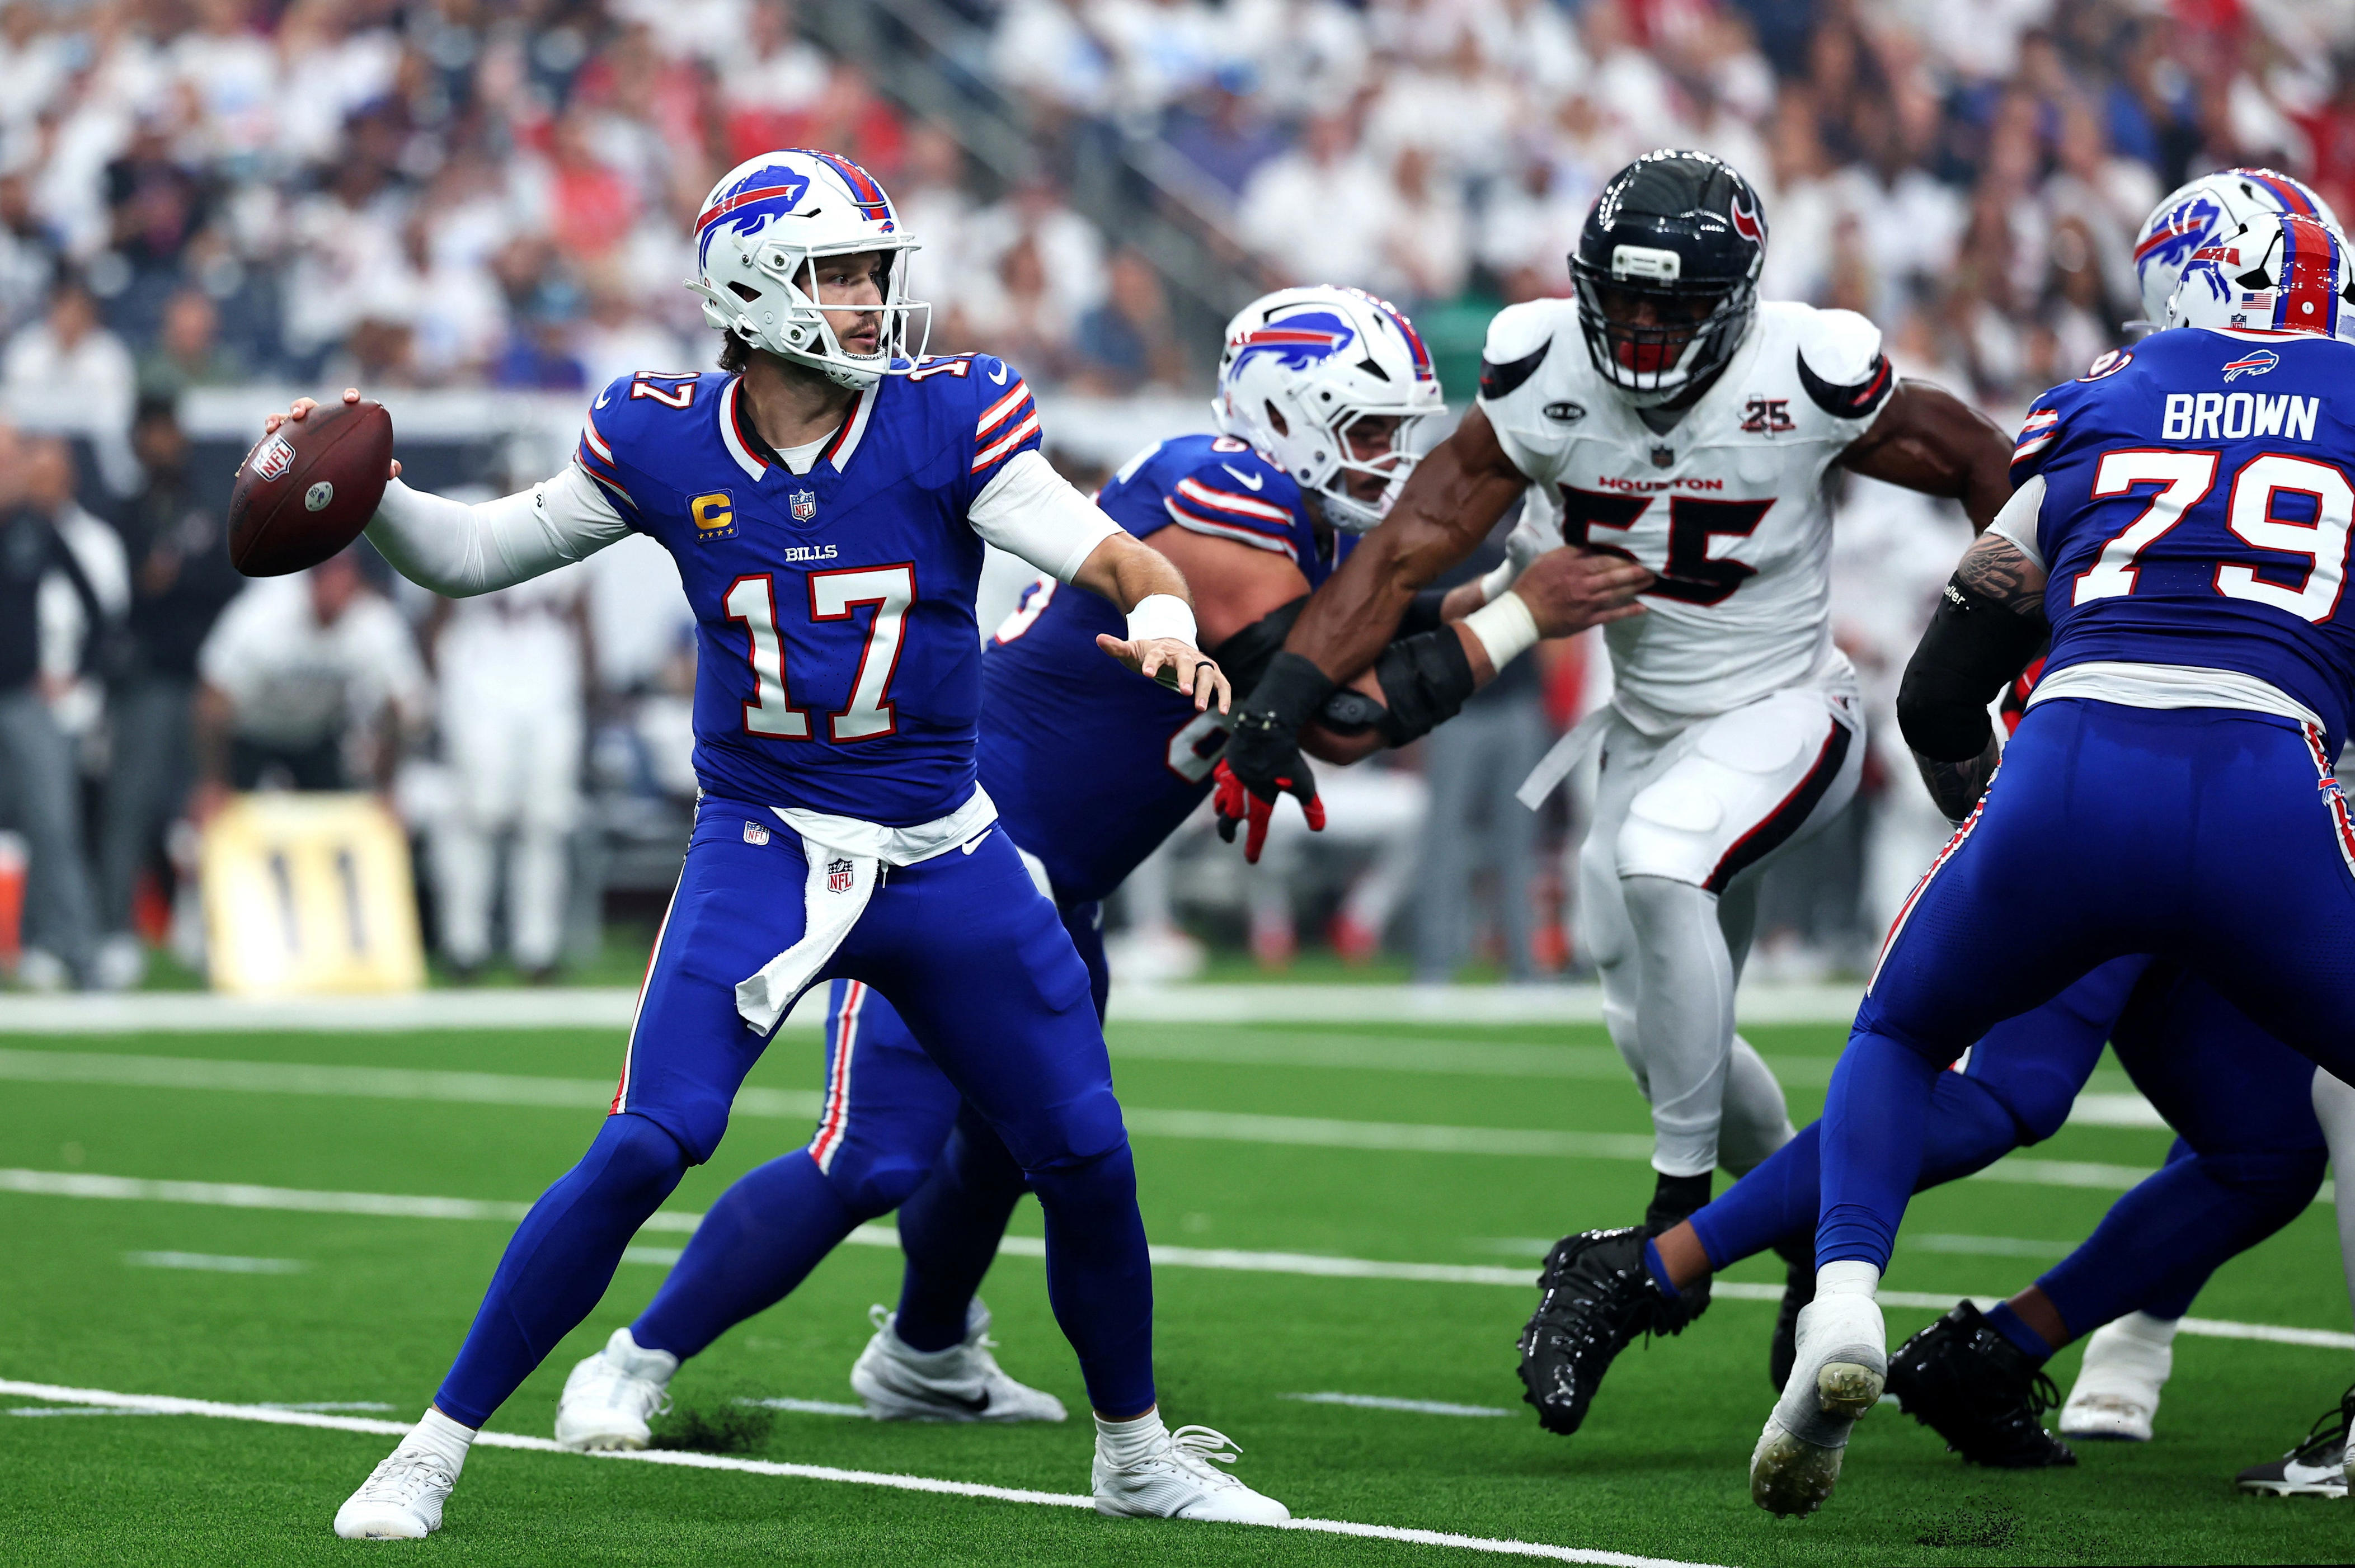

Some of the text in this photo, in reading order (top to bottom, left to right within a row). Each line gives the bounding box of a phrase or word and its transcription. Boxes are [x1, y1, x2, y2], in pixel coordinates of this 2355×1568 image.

[1740, 399, 1795, 432] 25
[2161, 392, 2320, 442] BROWN
[261, 447, 292, 477] NFL
[1598, 475, 1723, 493] HOUSTON
[691, 494, 733, 530] C
[795, 504, 812, 516] NFL
[1556, 482, 1779, 608] 55
[2070, 448, 2355, 626] 79
[784, 544, 838, 562] BILLS
[722, 561, 917, 745] 17
[748, 830, 765, 842] NFL
[830, 873, 852, 891] NFL
